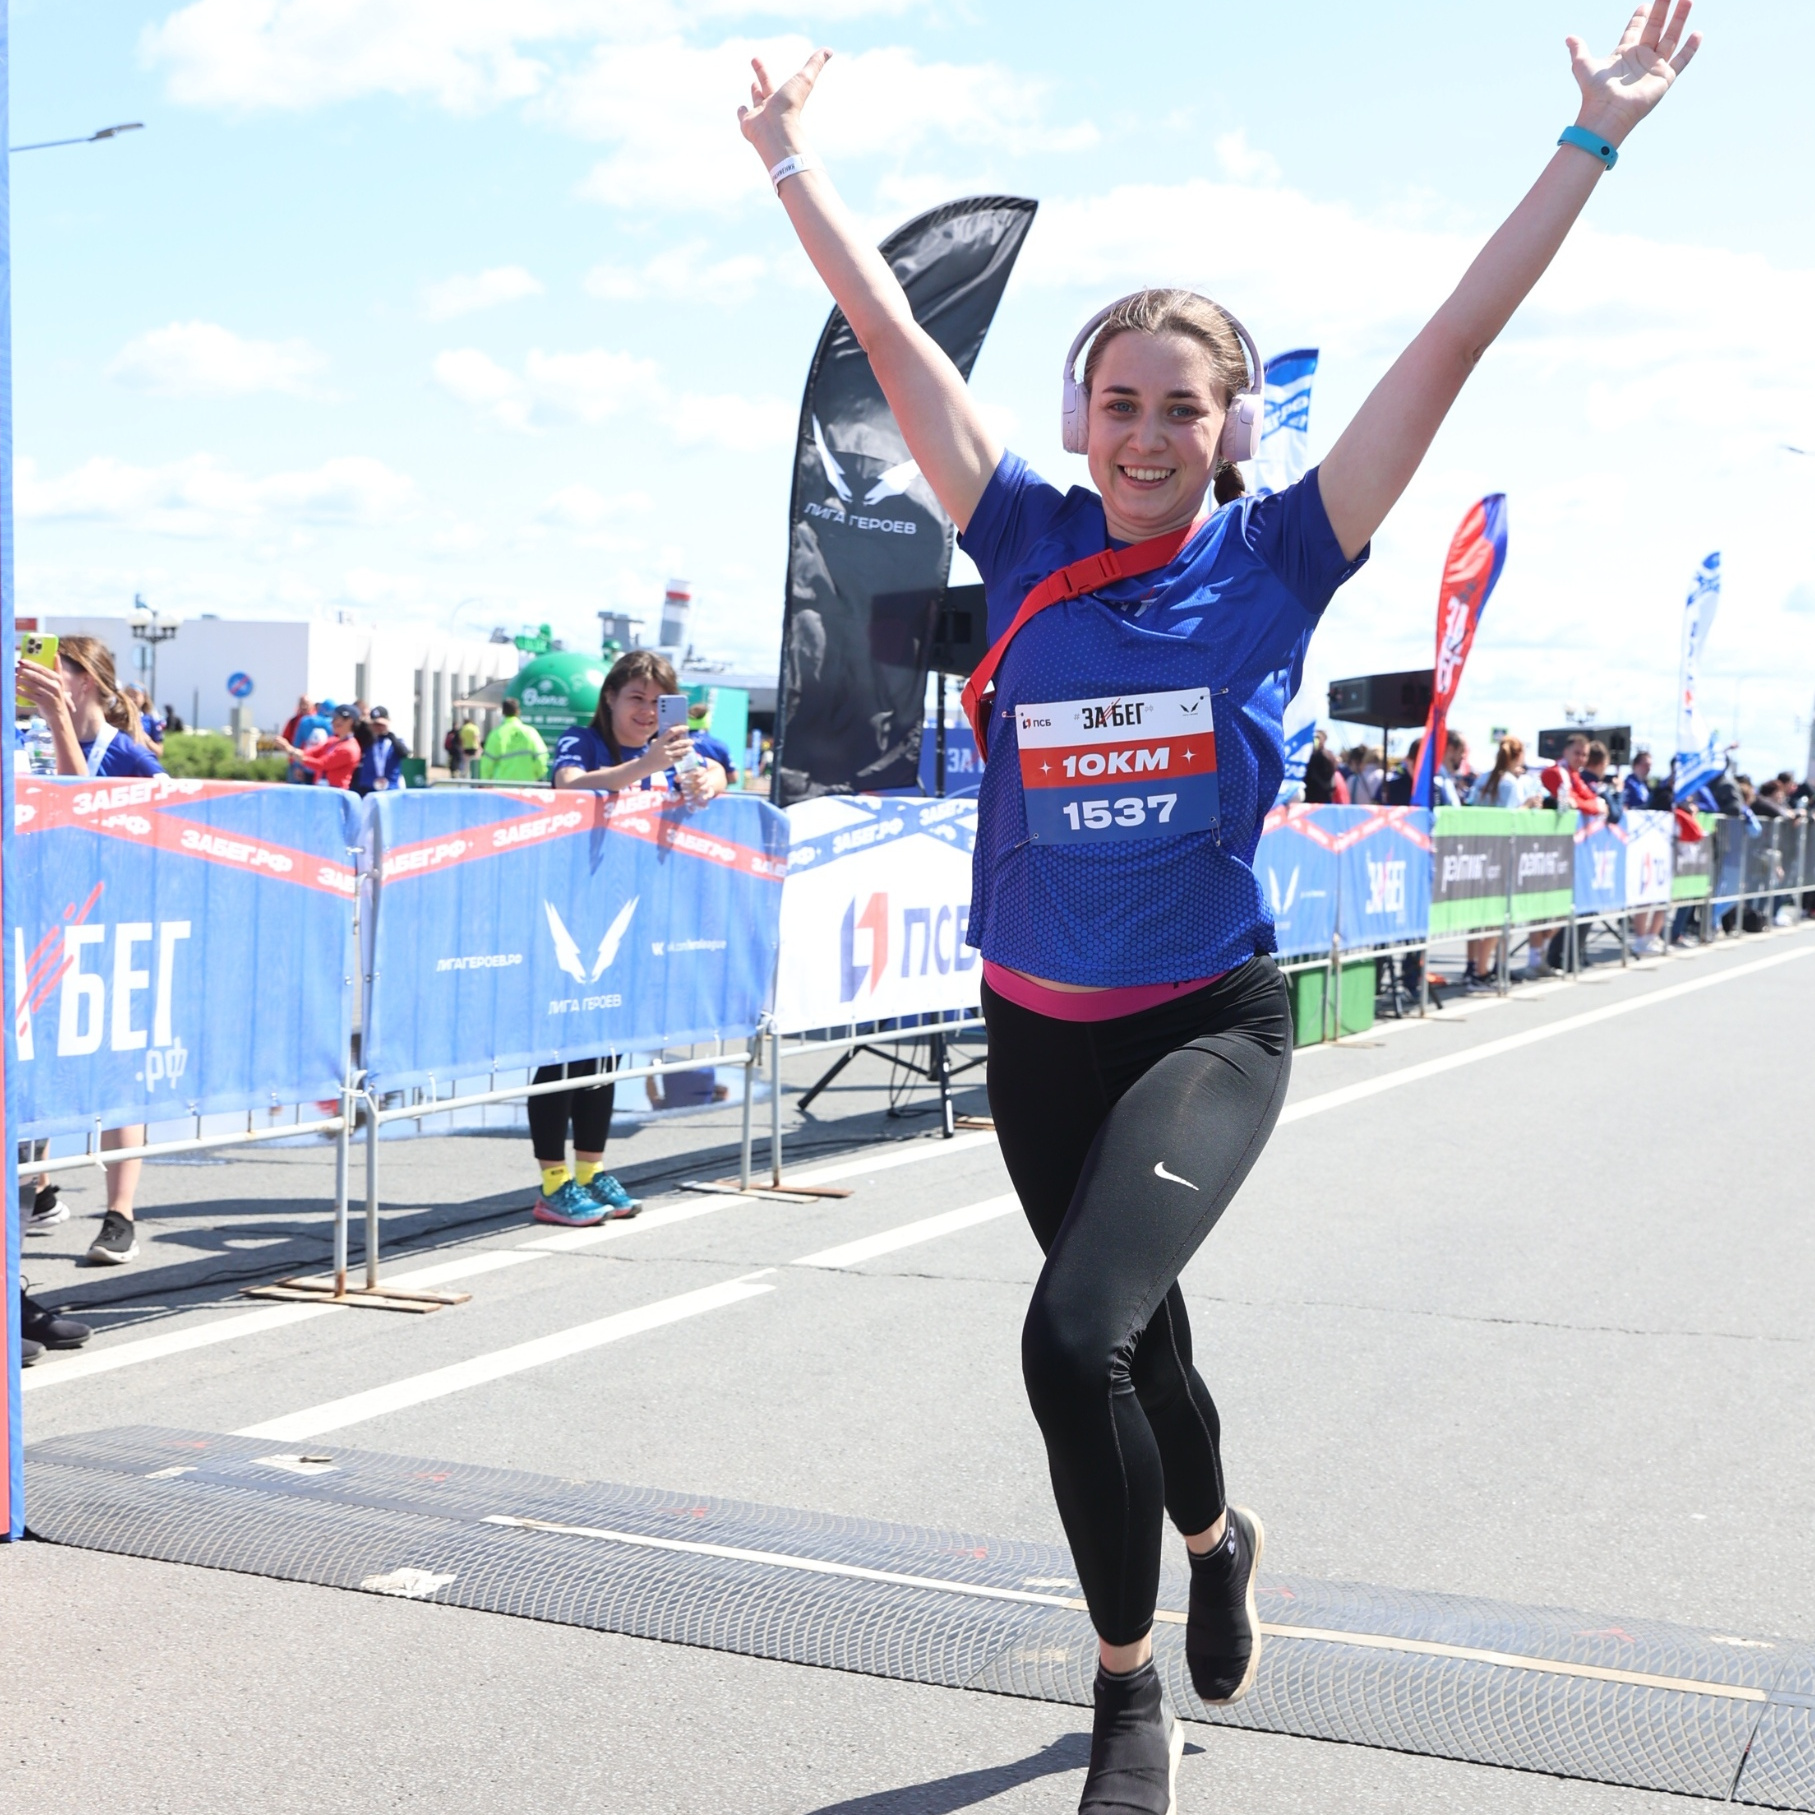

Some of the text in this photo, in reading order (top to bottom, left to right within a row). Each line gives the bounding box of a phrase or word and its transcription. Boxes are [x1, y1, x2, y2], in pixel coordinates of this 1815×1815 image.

[804, 502, 917, 535] ЛИГА ГЕРОЕВ
[1033, 719, 1052, 728] ПСБ
[1063, 747, 1170, 778] 10КМ
[72, 773, 204, 815] ЗАБЕГ.РФ
[1063, 793, 1178, 830] 1537
[492, 811, 583, 847] ЗАБЕГ.РФ
[180, 829, 293, 872] ЗАБЕГ.РФ
[548, 994, 622, 1015] ЛИГА ГЕРОЕВ
